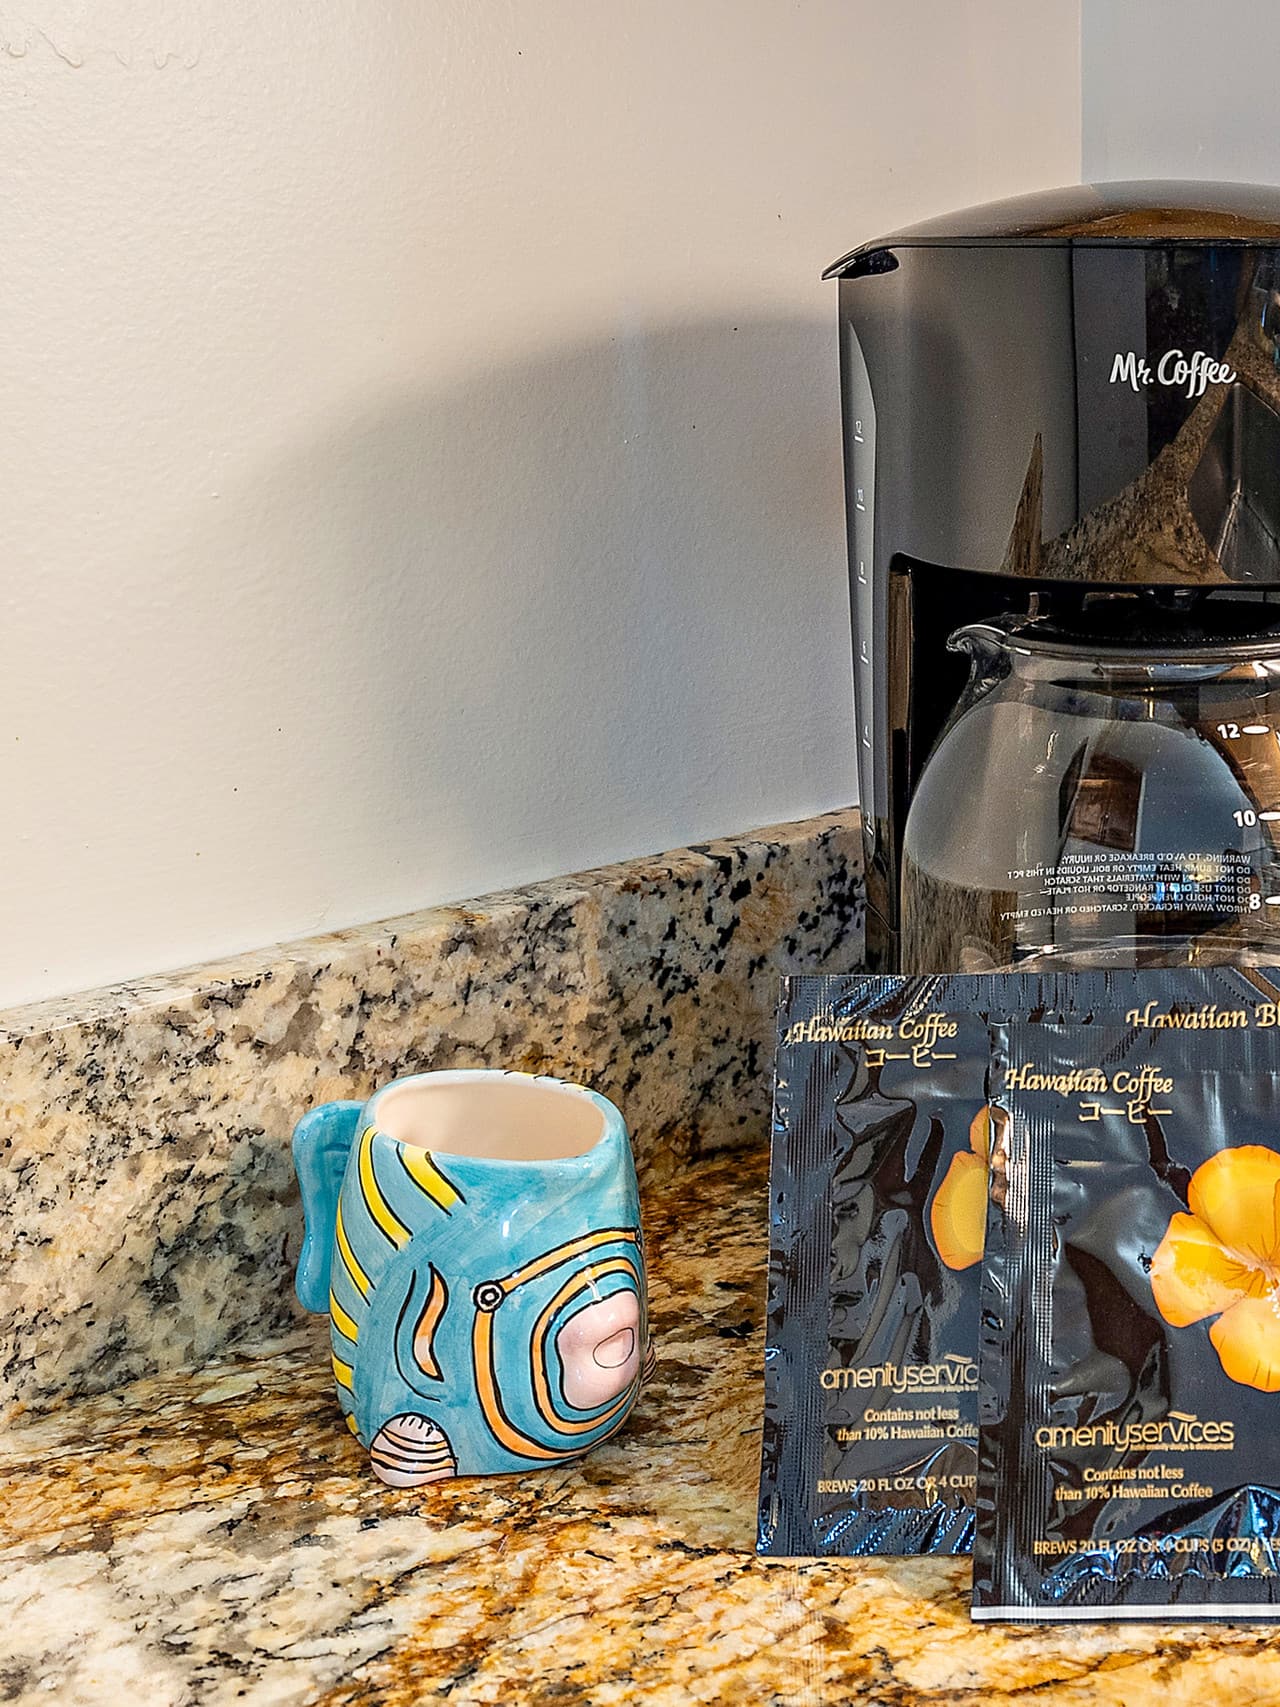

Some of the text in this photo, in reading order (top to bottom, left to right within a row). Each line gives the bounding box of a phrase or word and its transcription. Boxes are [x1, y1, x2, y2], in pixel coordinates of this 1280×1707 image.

[1109, 349, 1237, 399] Mr. Coffee
[1217, 723, 1241, 739] 12
[1232, 811, 1257, 827] 10
[1248, 893, 1262, 910] 8
[1126, 1001, 1249, 1030] Hawaiian
[793, 1013, 958, 1048] Hawaiian Coffee
[864, 1046, 958, 1068] コーヒー
[1005, 1063, 1174, 1103] Hawaiian Coffee
[1078, 1101, 1173, 1124] コーヒー
[820, 1359, 978, 1393] amenityservic
[863, 1406, 960, 1423] Contains not less
[837, 1424, 979, 1441] than 10% Hawaiian Coffe
[1035, 1418, 1235, 1452] amenityservices
[1083, 1464, 1185, 1482] Contains not less
[817, 1475, 977, 1494] BREWS 20 FL OZ OR 4 CUP
[1055, 1483, 1214, 1501] than 10% Hawaiian Coffee
[1033, 1539, 1078, 1555] BREWS
[1079, 1539, 1096, 1553] 20
[1116, 1538, 1138, 1553] OZ
[1174, 1539, 1210, 1553] CUPS
[1211, 1538, 1225, 1554] (5
[1226, 1537, 1251, 1553] OZ)
